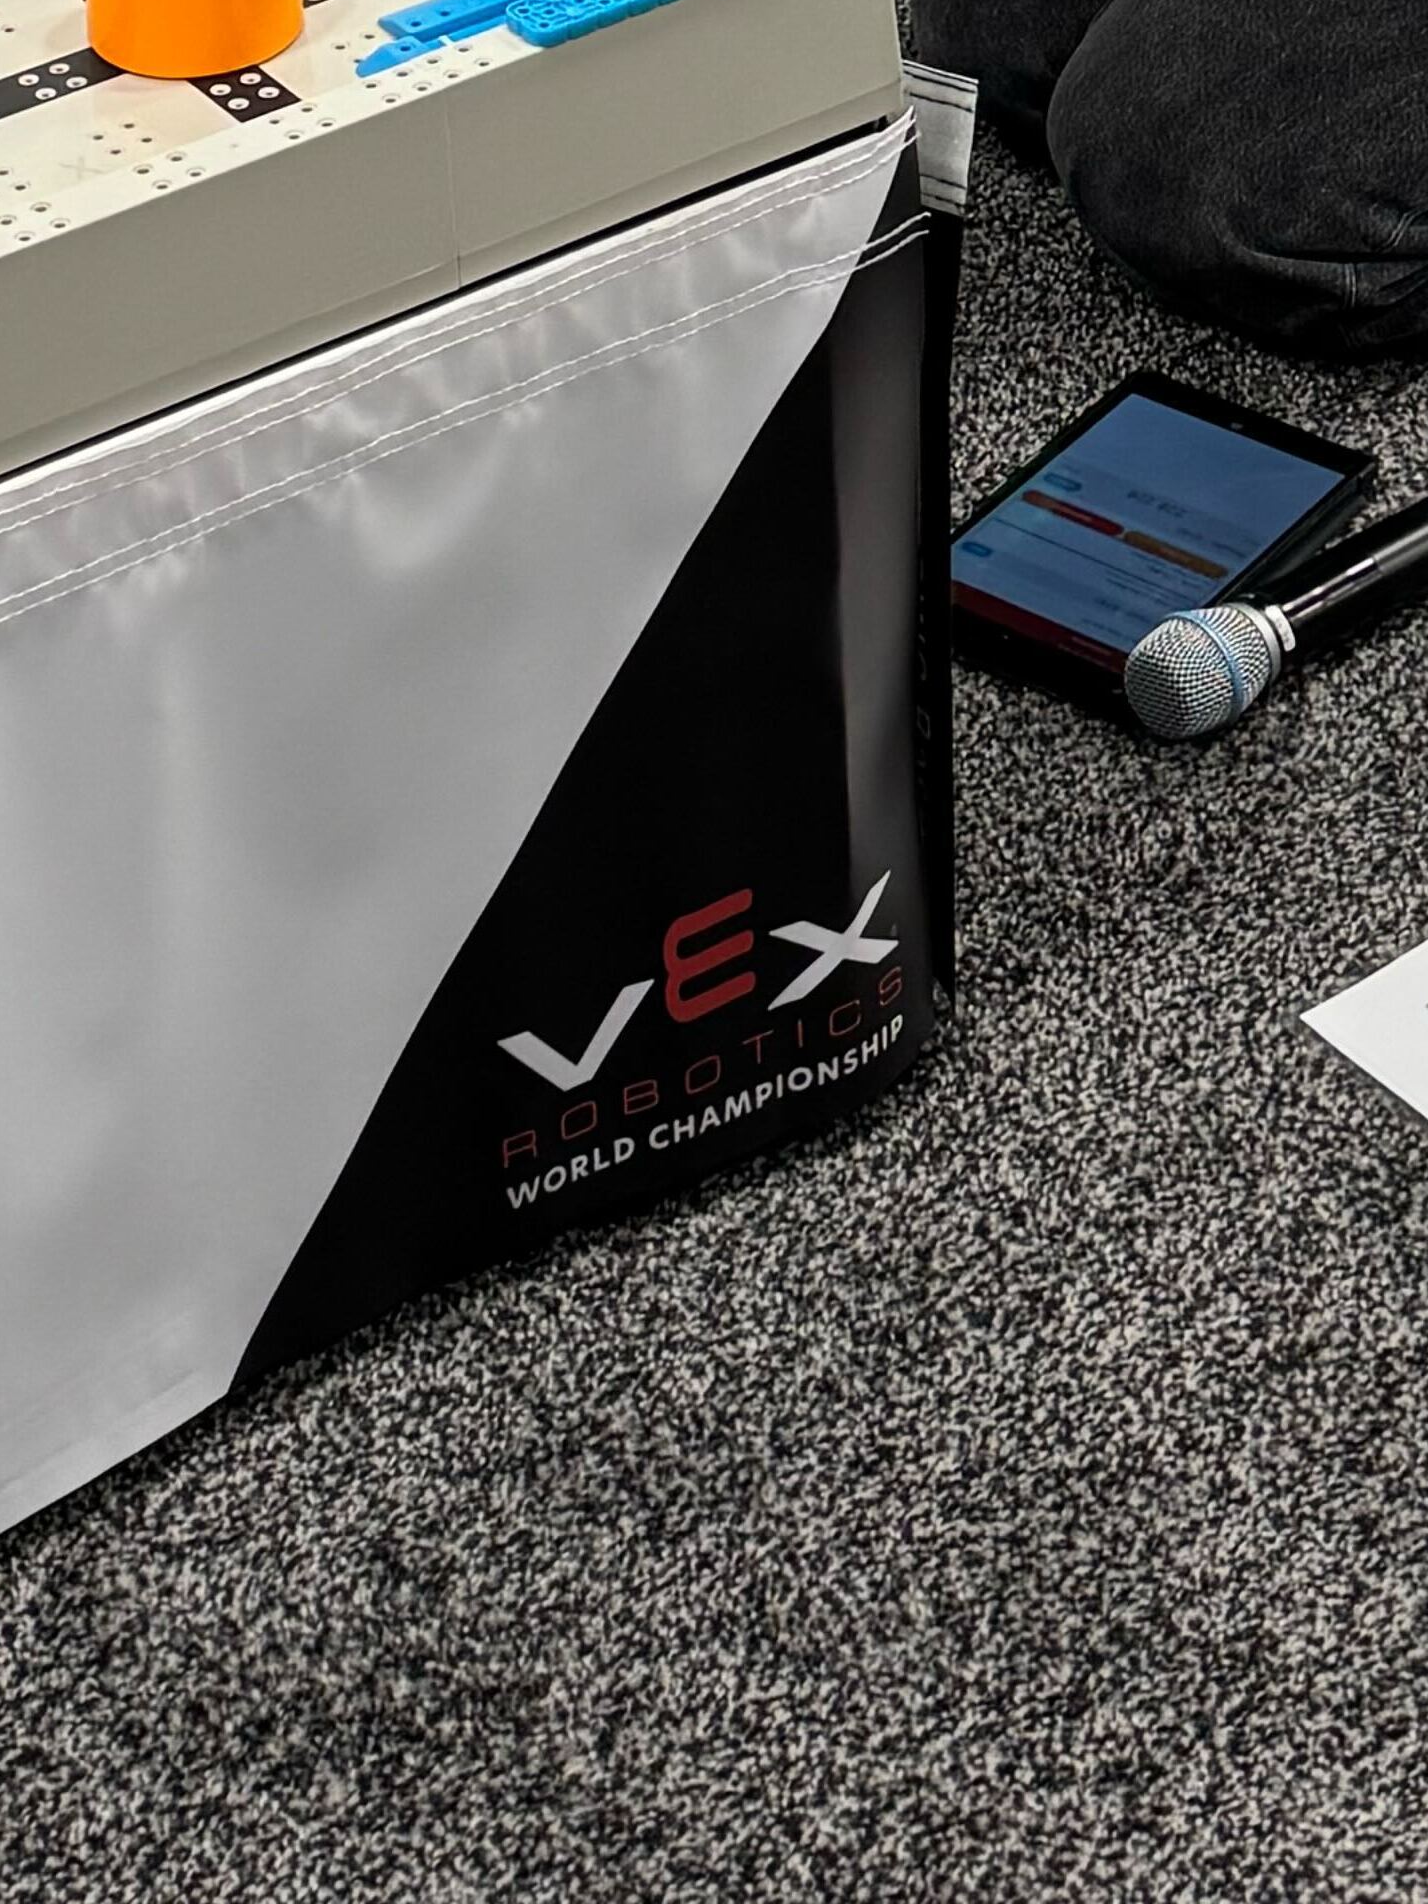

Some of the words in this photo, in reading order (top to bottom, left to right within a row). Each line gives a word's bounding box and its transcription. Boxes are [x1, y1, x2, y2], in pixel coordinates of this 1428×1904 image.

[497, 869, 900, 1092] VEX
[502, 966, 903, 1169] ROBOTICS
[505, 1136, 636, 1210] WORLD
[649, 1013, 904, 1151] CHAMPIONSHIP
